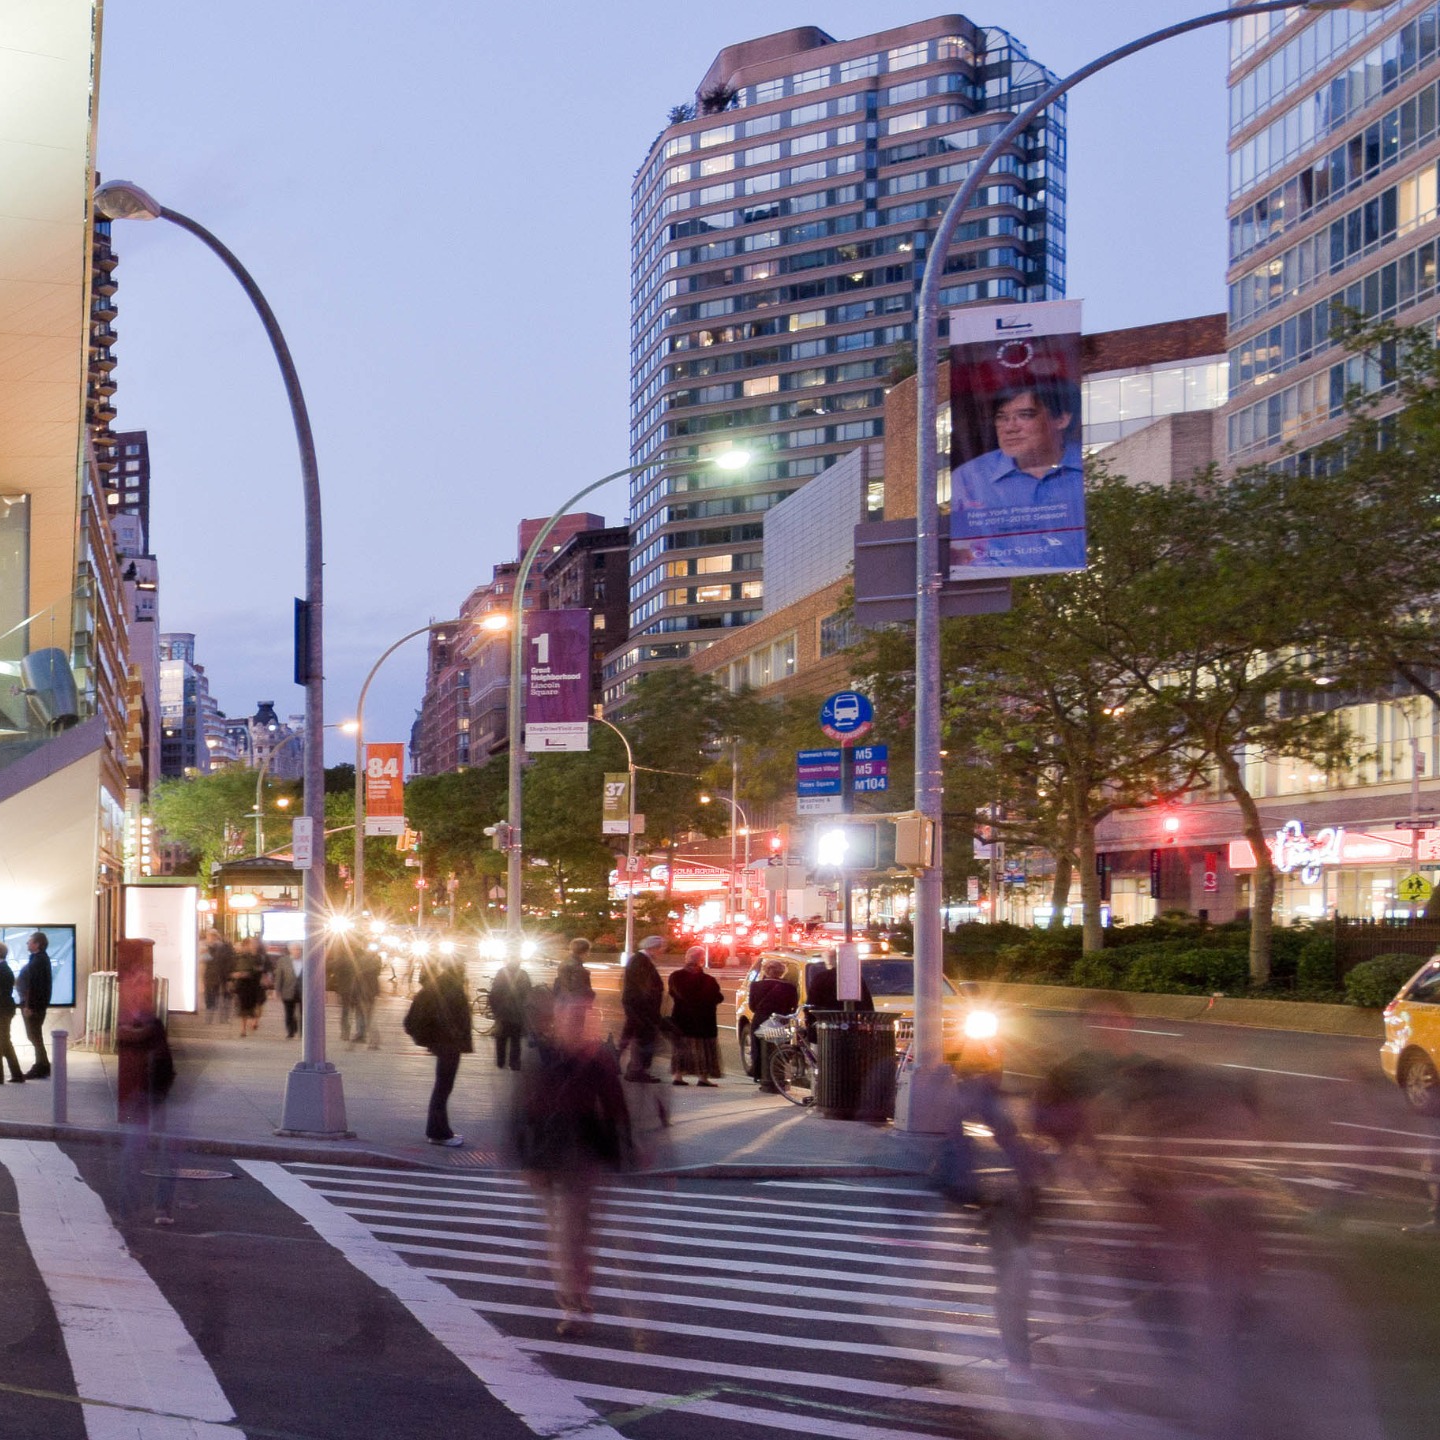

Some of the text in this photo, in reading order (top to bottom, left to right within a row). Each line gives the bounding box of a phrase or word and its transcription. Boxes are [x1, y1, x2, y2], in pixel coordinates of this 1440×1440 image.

[967, 511, 987, 519] New
[989, 509, 1008, 517] York
[968, 519, 983, 527] the
[1033, 512, 1067, 521] Season
[972, 546, 1050, 559] CREDIT SUISSE
[531, 632, 549, 663] 1
[530, 666, 551, 674] Great
[530, 672, 581, 682] Neighborhood
[530, 688, 559, 696] Square
[855, 747, 873, 760] M5
[368, 758, 399, 778] 84
[855, 763, 873, 775] M5
[605, 782, 626, 796] 37
[854, 777, 886, 790] M104
